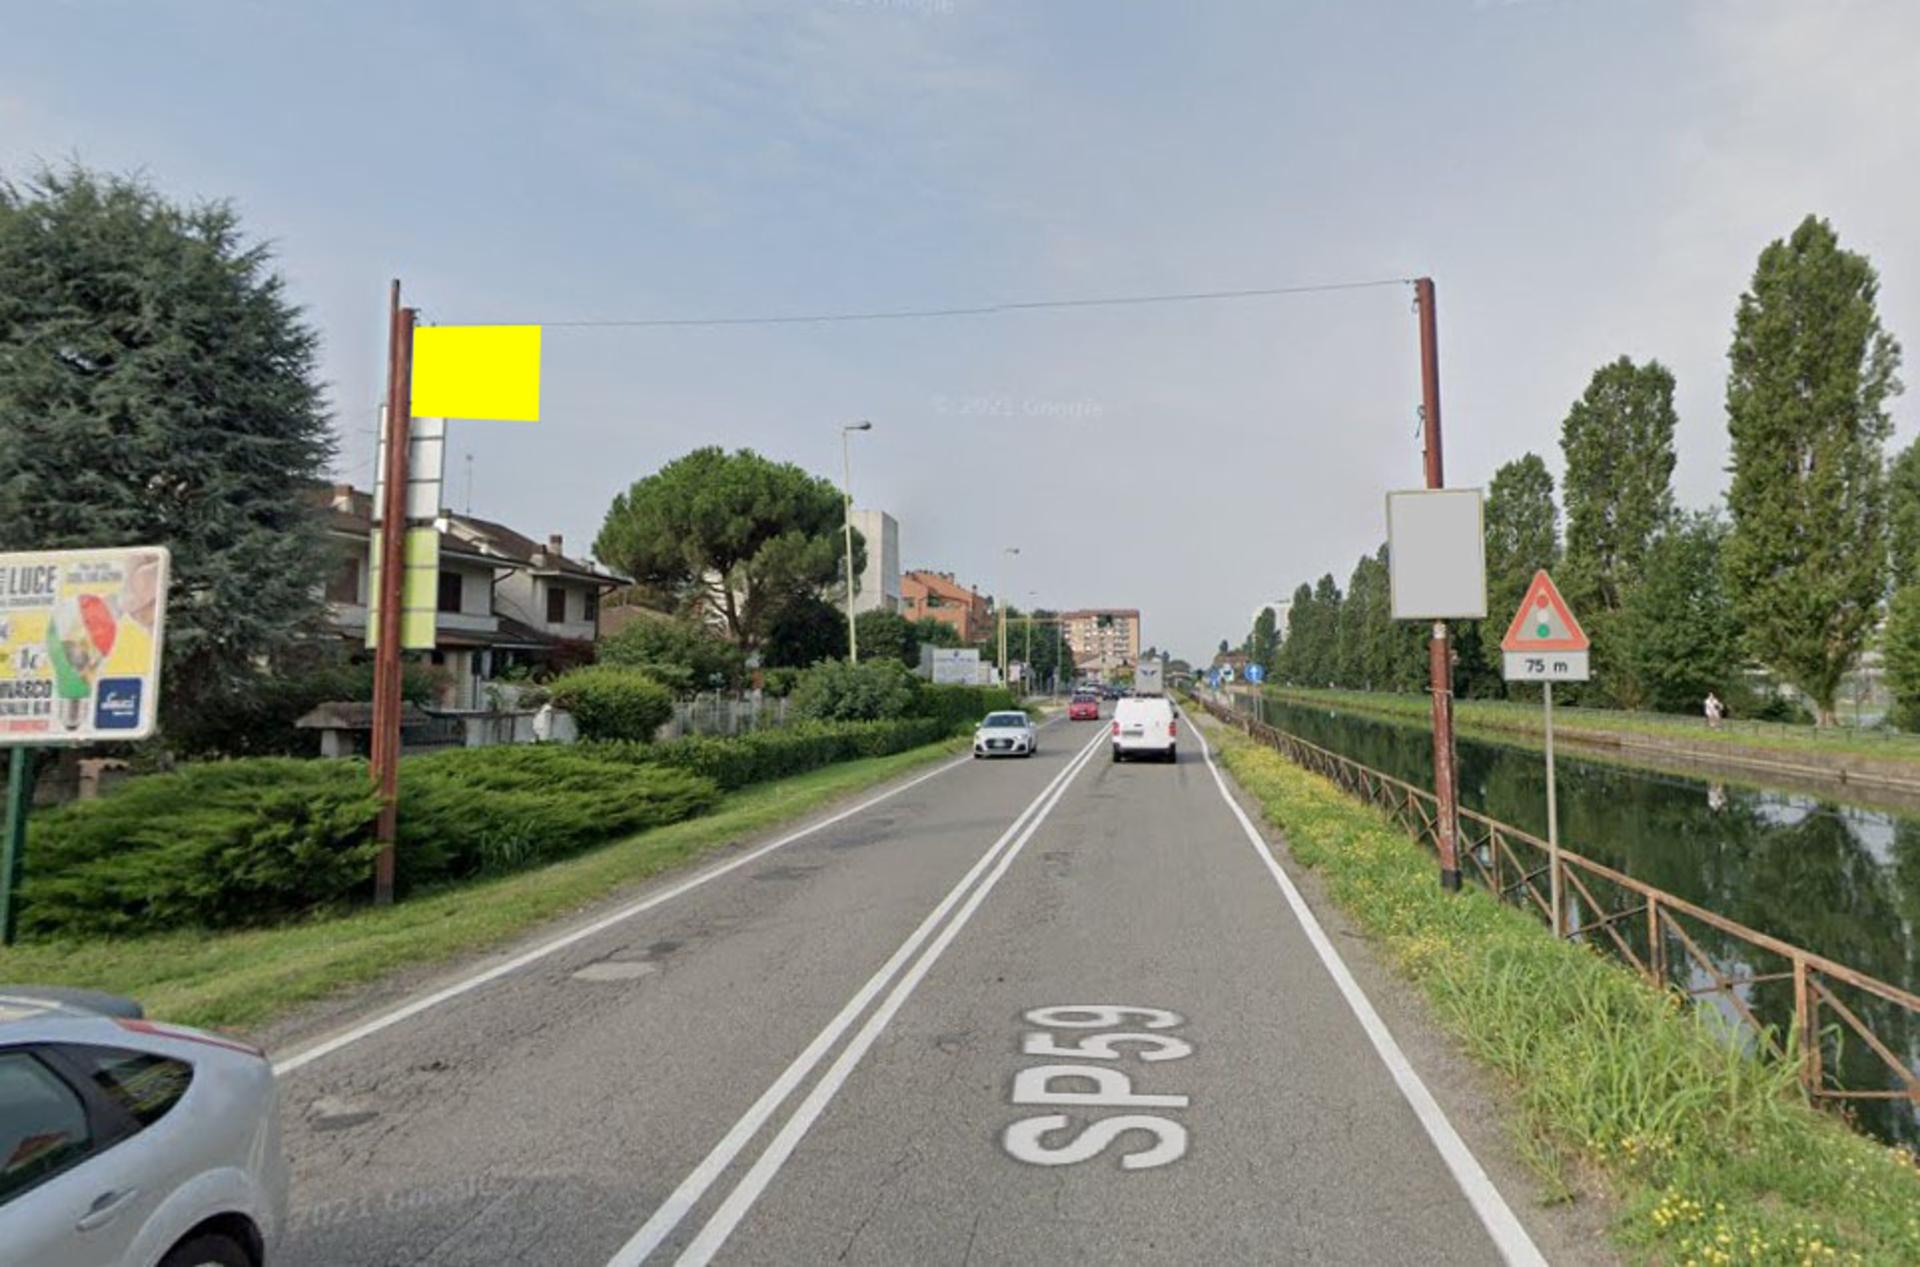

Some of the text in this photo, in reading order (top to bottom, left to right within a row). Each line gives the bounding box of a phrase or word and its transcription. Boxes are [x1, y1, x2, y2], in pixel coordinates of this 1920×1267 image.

[9, 565, 57, 595] LUCE
[1525, 658, 1568, 673] 75 m
[1004, 1004, 1193, 1169] SP59
